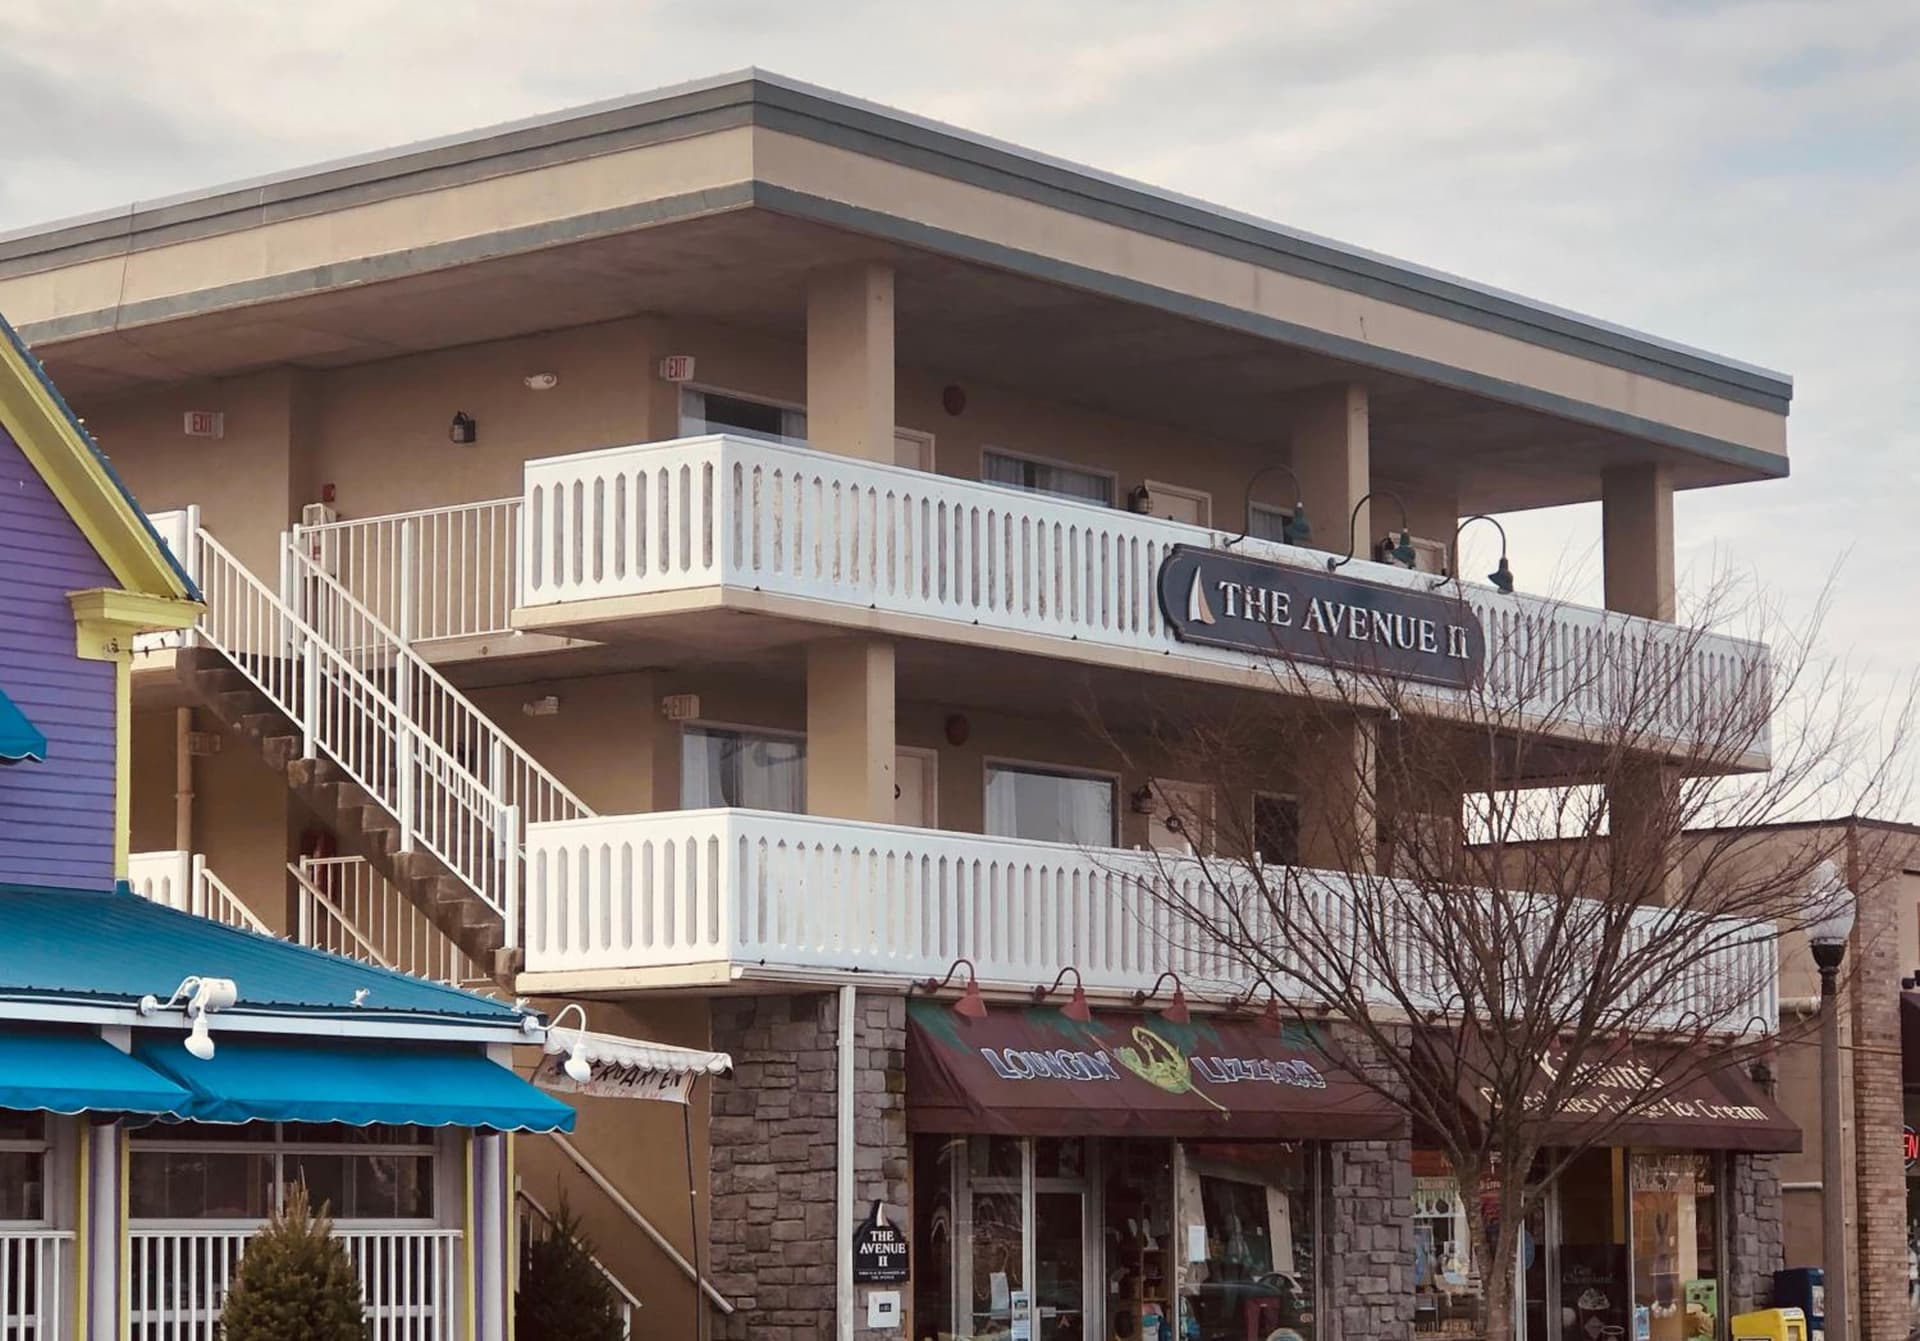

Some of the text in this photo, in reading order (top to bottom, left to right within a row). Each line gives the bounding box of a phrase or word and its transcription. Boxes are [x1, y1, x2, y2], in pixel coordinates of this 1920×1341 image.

[668, 357, 688, 378] EXIT
[192, 413, 212, 433] EXIT
[1218, 580, 1470, 659] THE AVENUE II
[1663, 1097, 1700, 1118] Ice
[1695, 1099, 1769, 1121] Cream
[870, 1230, 894, 1242] THE
[859, 1242, 906, 1254] AVENUE
[878, 1255, 888, 1267] II
